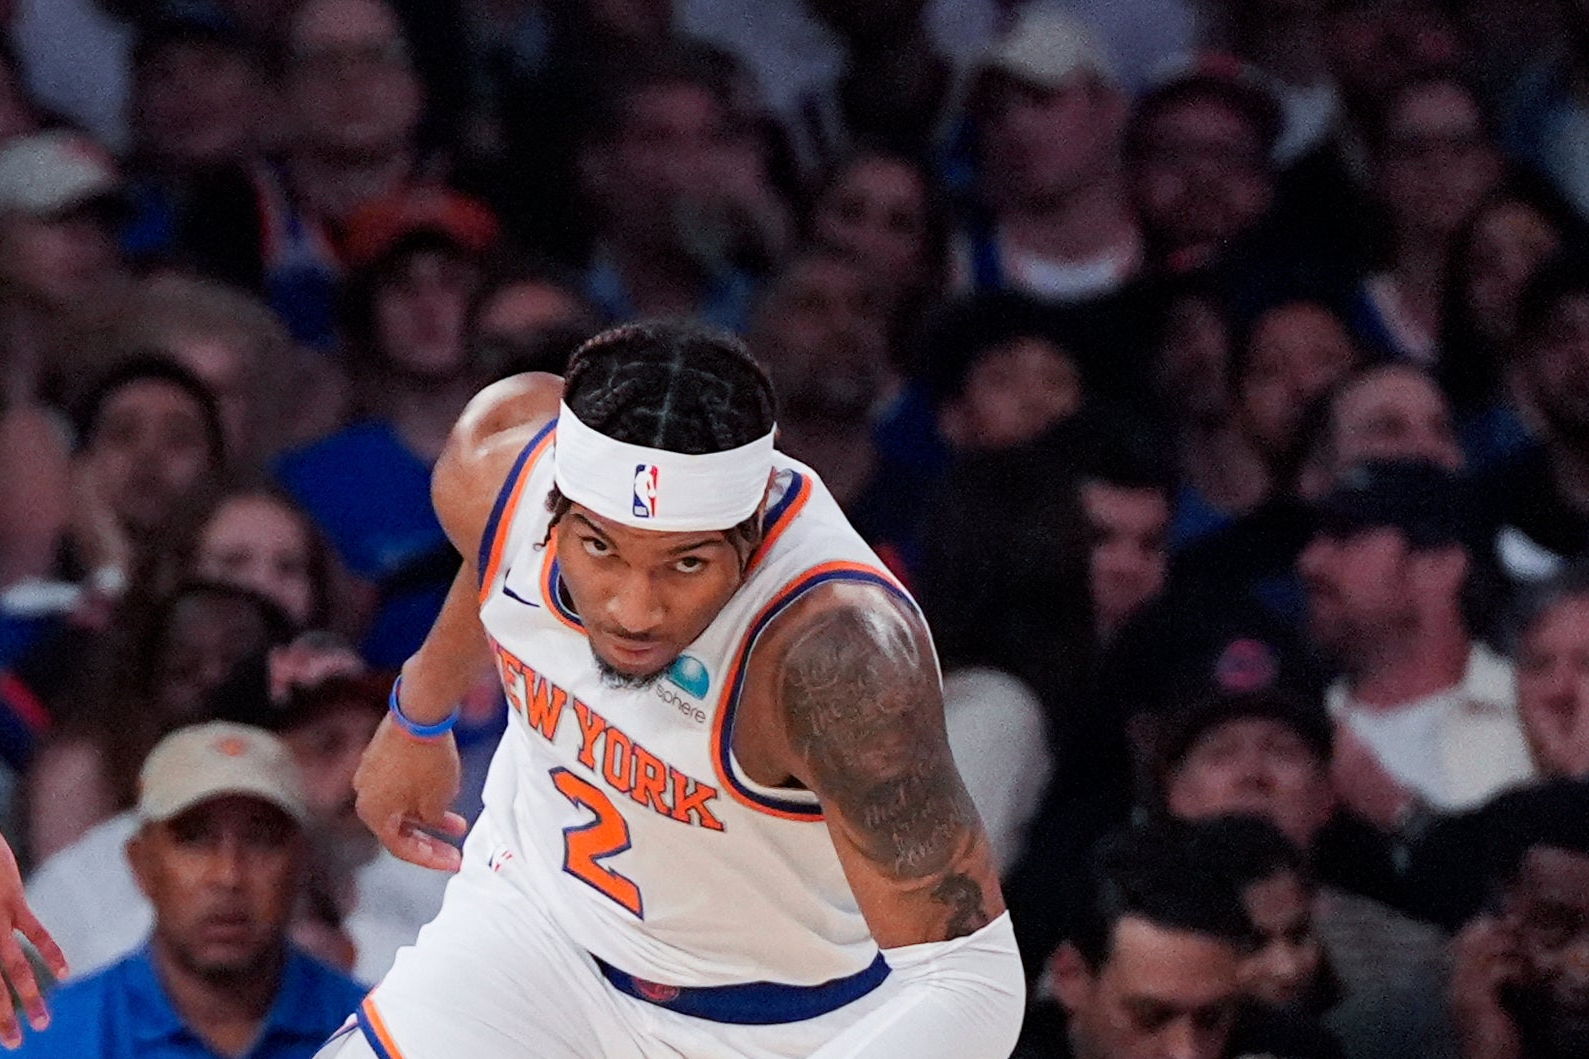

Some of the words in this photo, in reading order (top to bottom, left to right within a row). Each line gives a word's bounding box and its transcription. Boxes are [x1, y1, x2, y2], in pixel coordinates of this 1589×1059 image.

[489, 636, 567, 742] EW
[573, 696, 726, 832] YORK
[548, 766, 644, 921] 2
